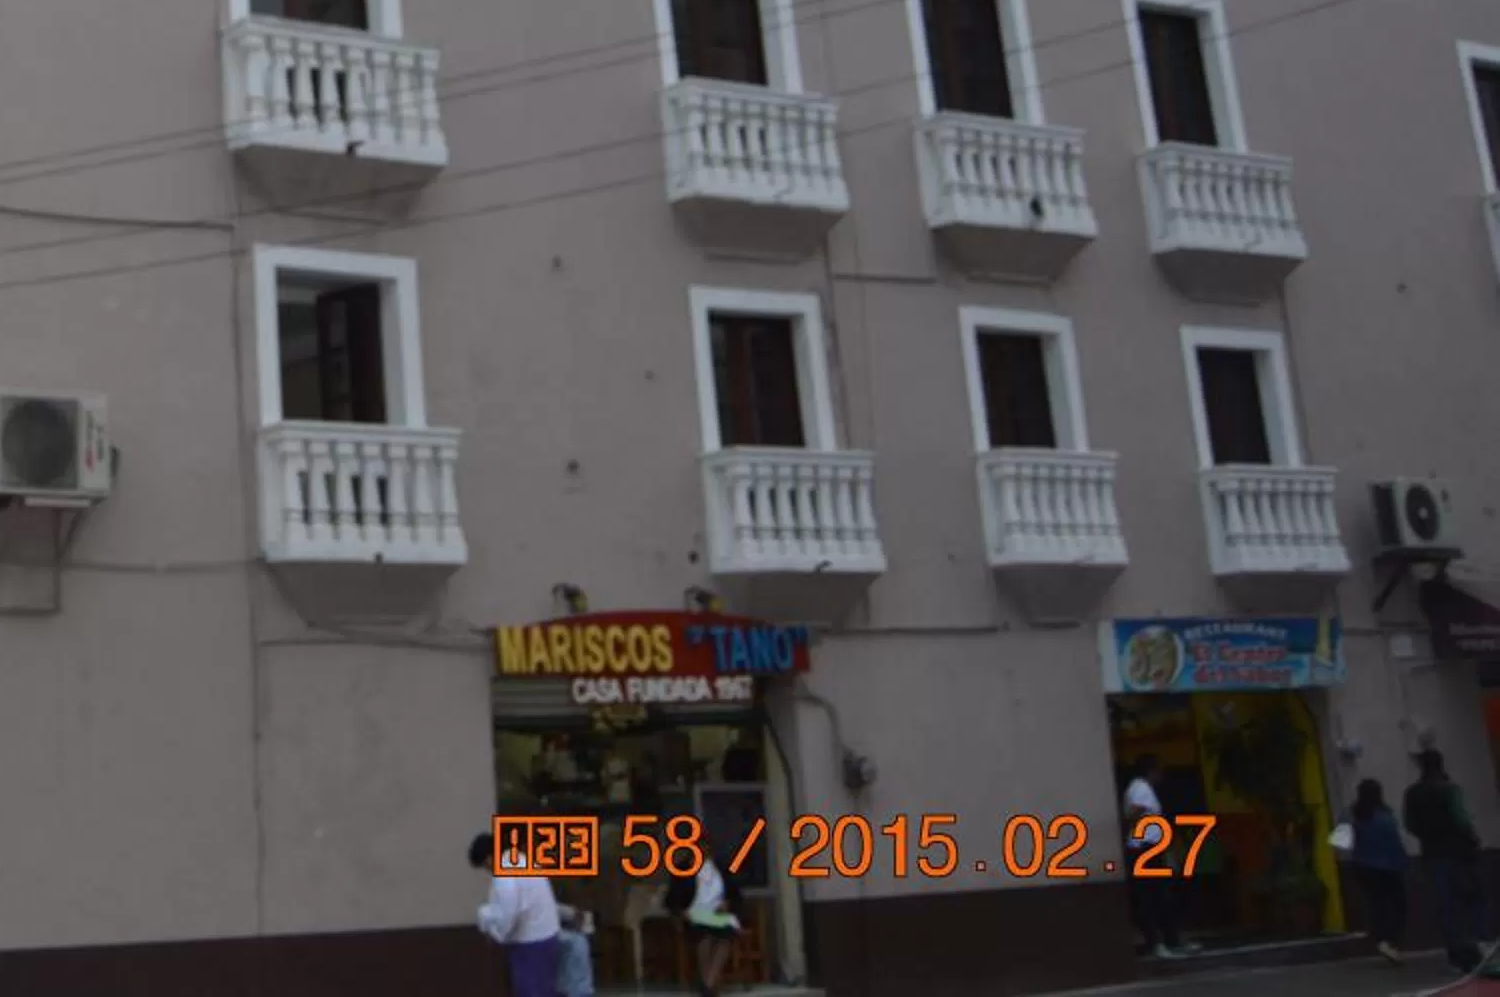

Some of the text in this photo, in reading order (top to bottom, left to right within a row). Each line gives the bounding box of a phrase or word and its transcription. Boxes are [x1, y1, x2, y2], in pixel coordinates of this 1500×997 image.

[500, 622, 674, 675] MARISCOS
[572, 676, 623, 703] CASA
[627, 675, 712, 702] FUNDADA
